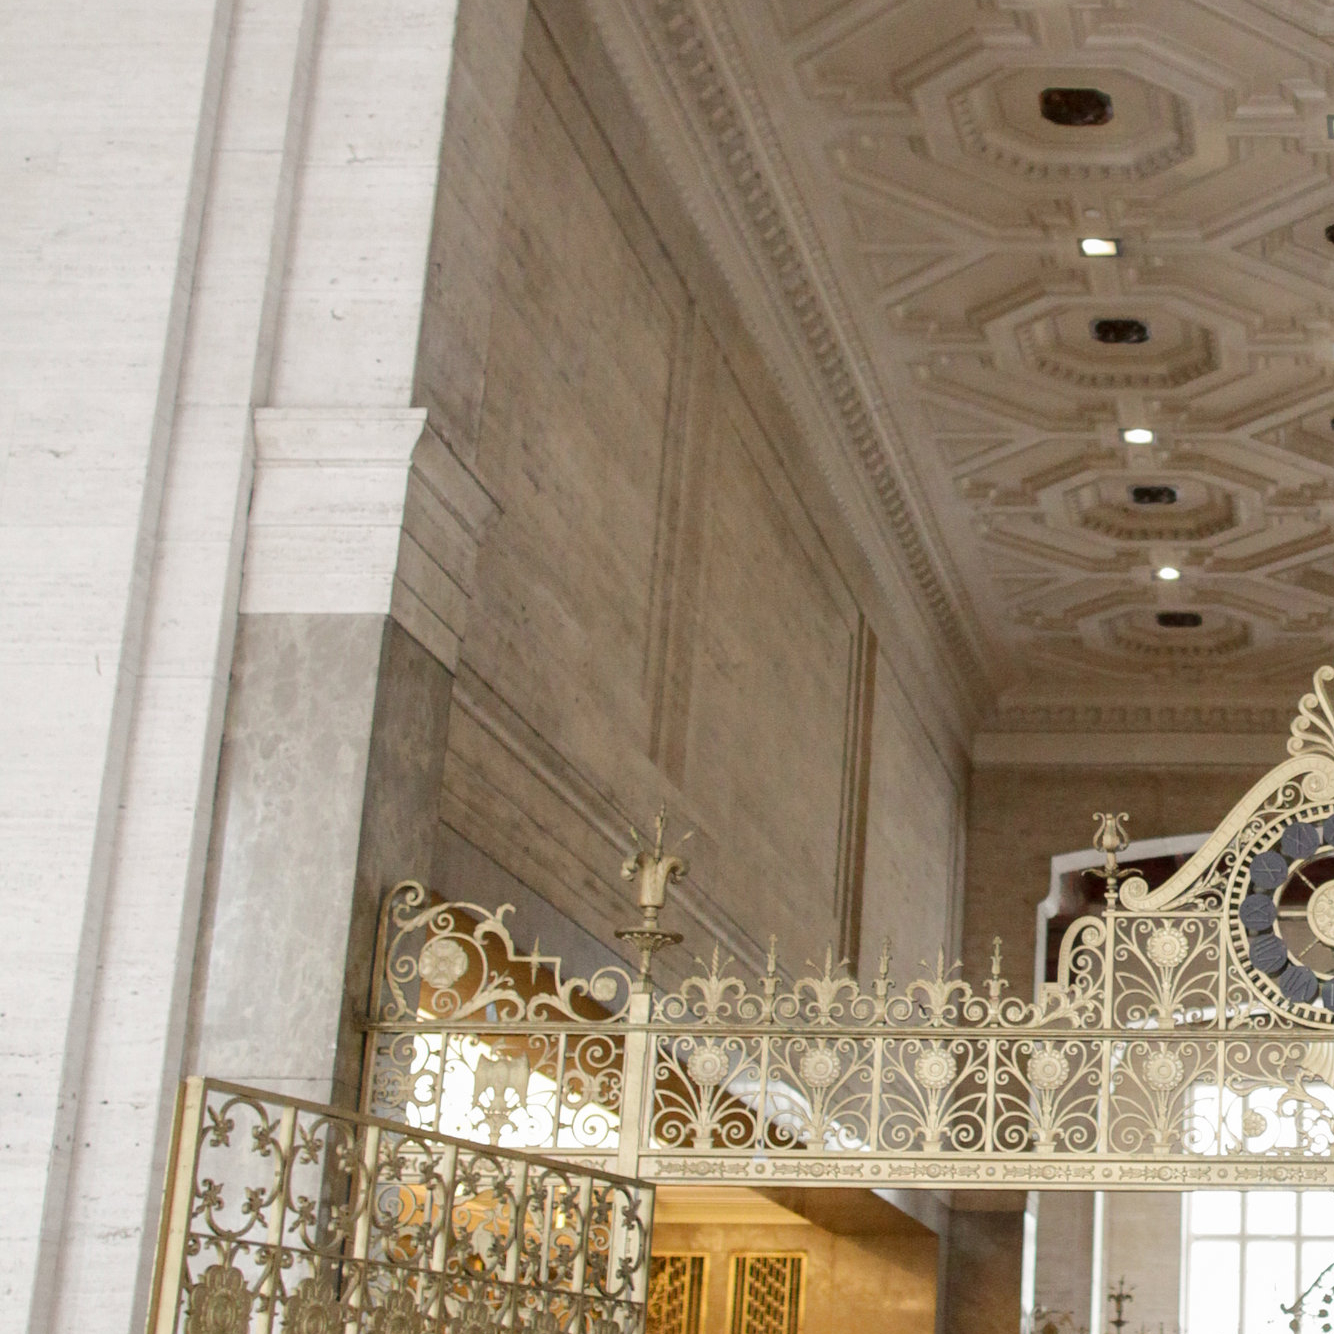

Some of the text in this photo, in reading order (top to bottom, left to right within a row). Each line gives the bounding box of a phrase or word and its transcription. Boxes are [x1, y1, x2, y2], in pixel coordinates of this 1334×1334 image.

[1286, 826, 1314, 853] XI
[1254, 856, 1282, 882] X
[1246, 902, 1270, 922] IX
